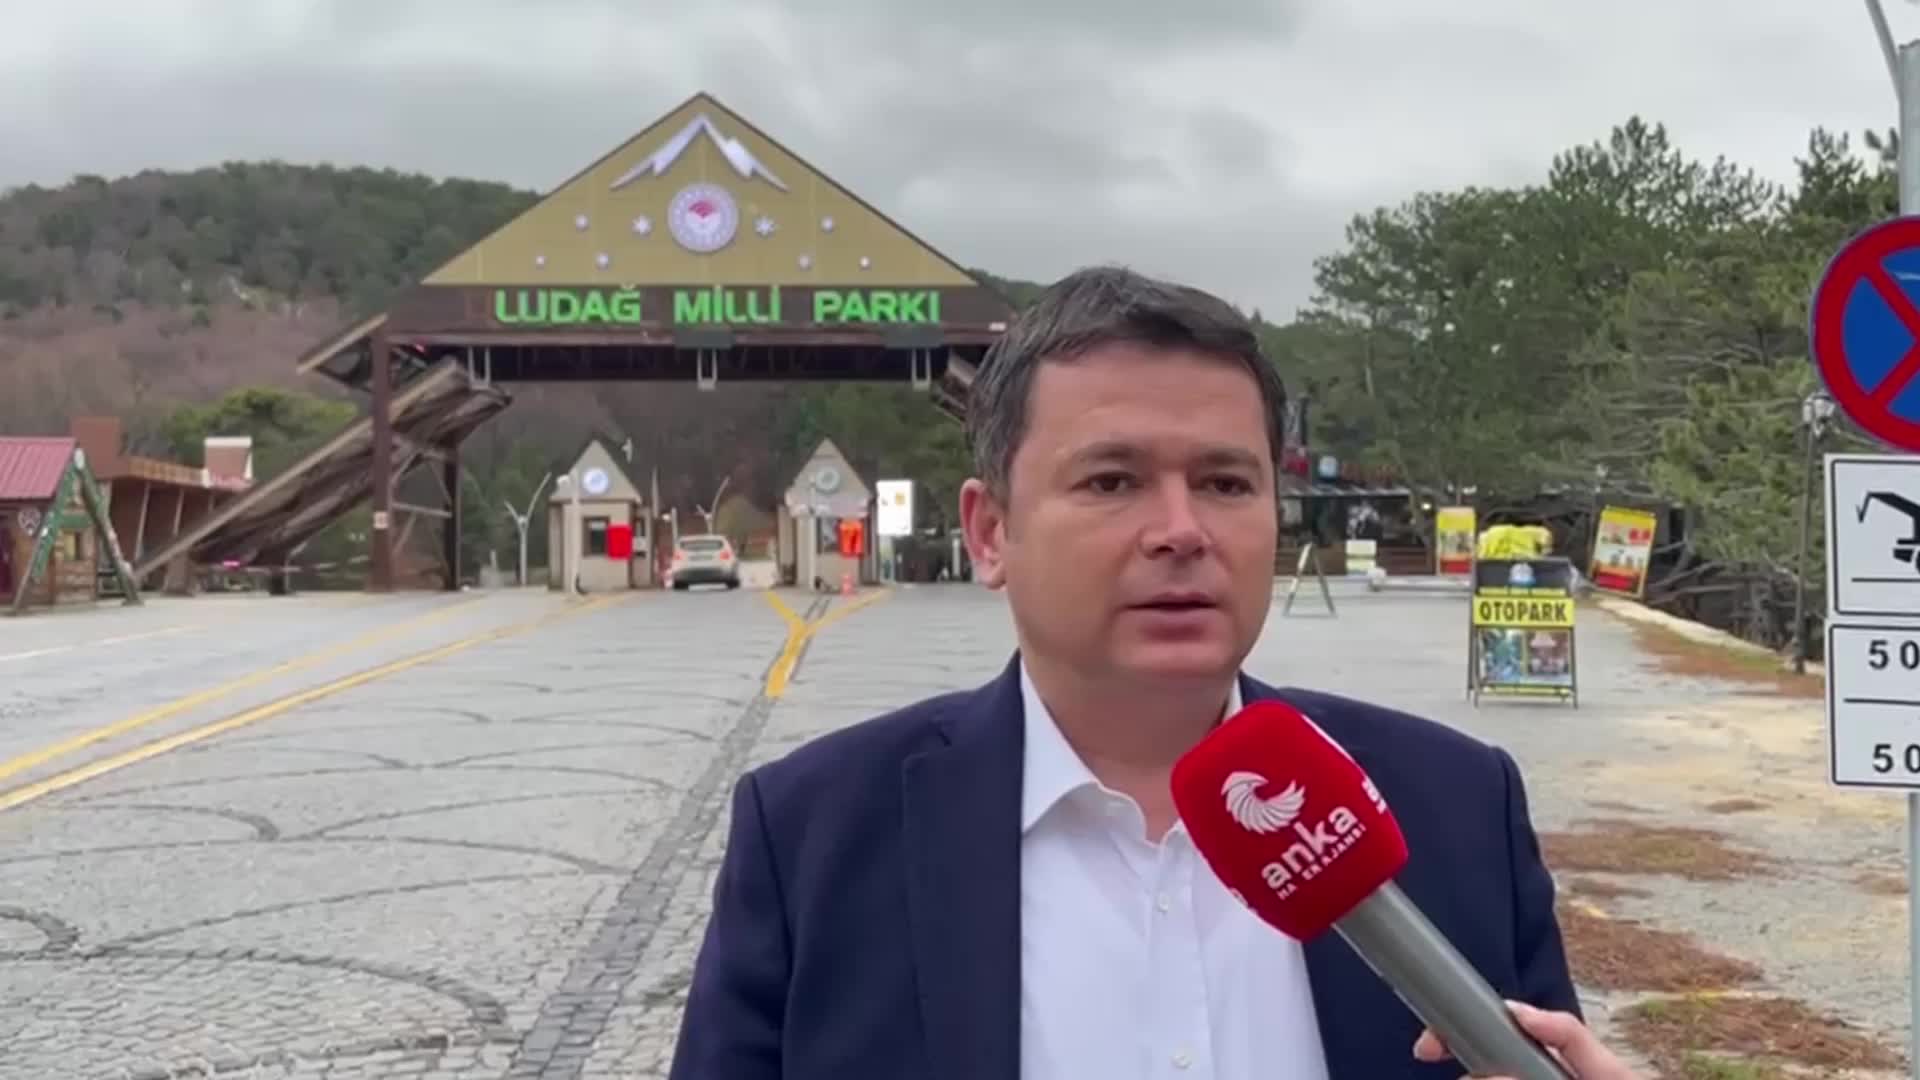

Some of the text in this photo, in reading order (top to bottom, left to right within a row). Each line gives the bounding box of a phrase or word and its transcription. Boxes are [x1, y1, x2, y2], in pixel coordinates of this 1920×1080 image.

[673, 284, 781, 324] MİLLİ
[813, 290, 940, 324] PARKI
[1478, 600, 1567, 622] OTOPARK
[1261, 806, 1358, 889] anka
